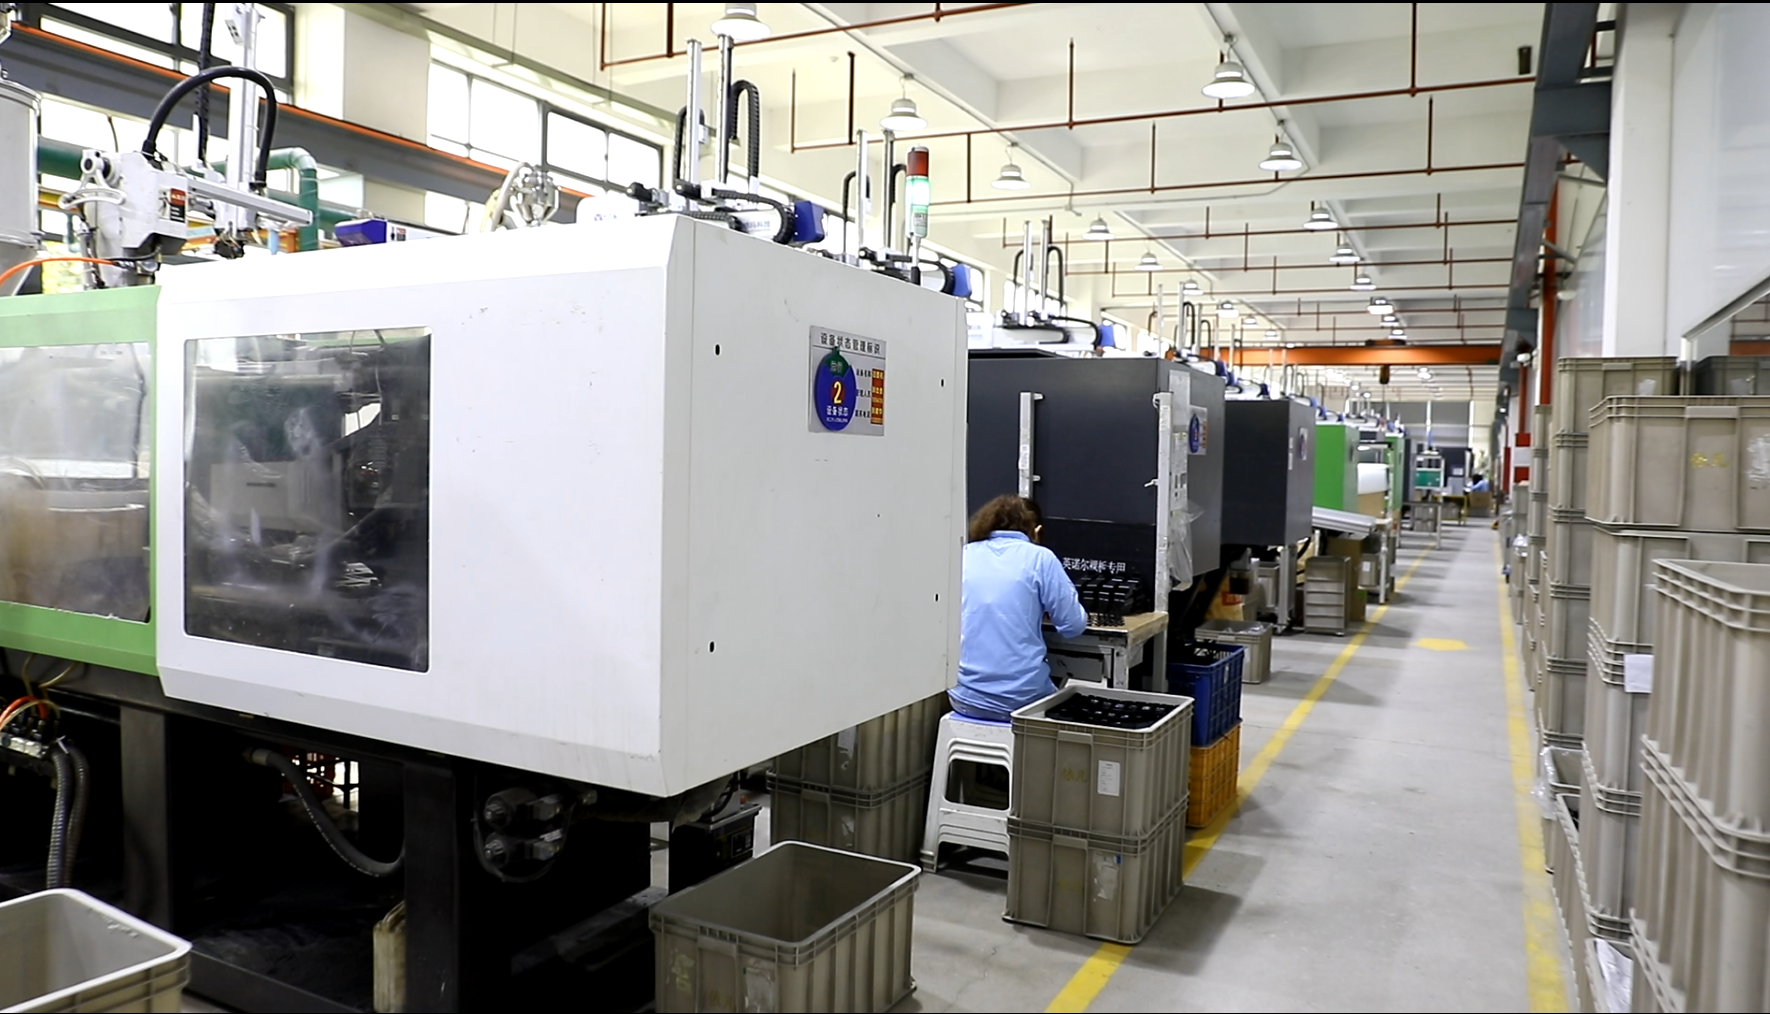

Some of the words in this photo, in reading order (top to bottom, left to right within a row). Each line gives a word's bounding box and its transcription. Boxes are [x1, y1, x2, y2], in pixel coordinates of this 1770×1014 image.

[820, 332, 880, 355] 设备状态管理标识
[833, 381, 842, 404] 2
